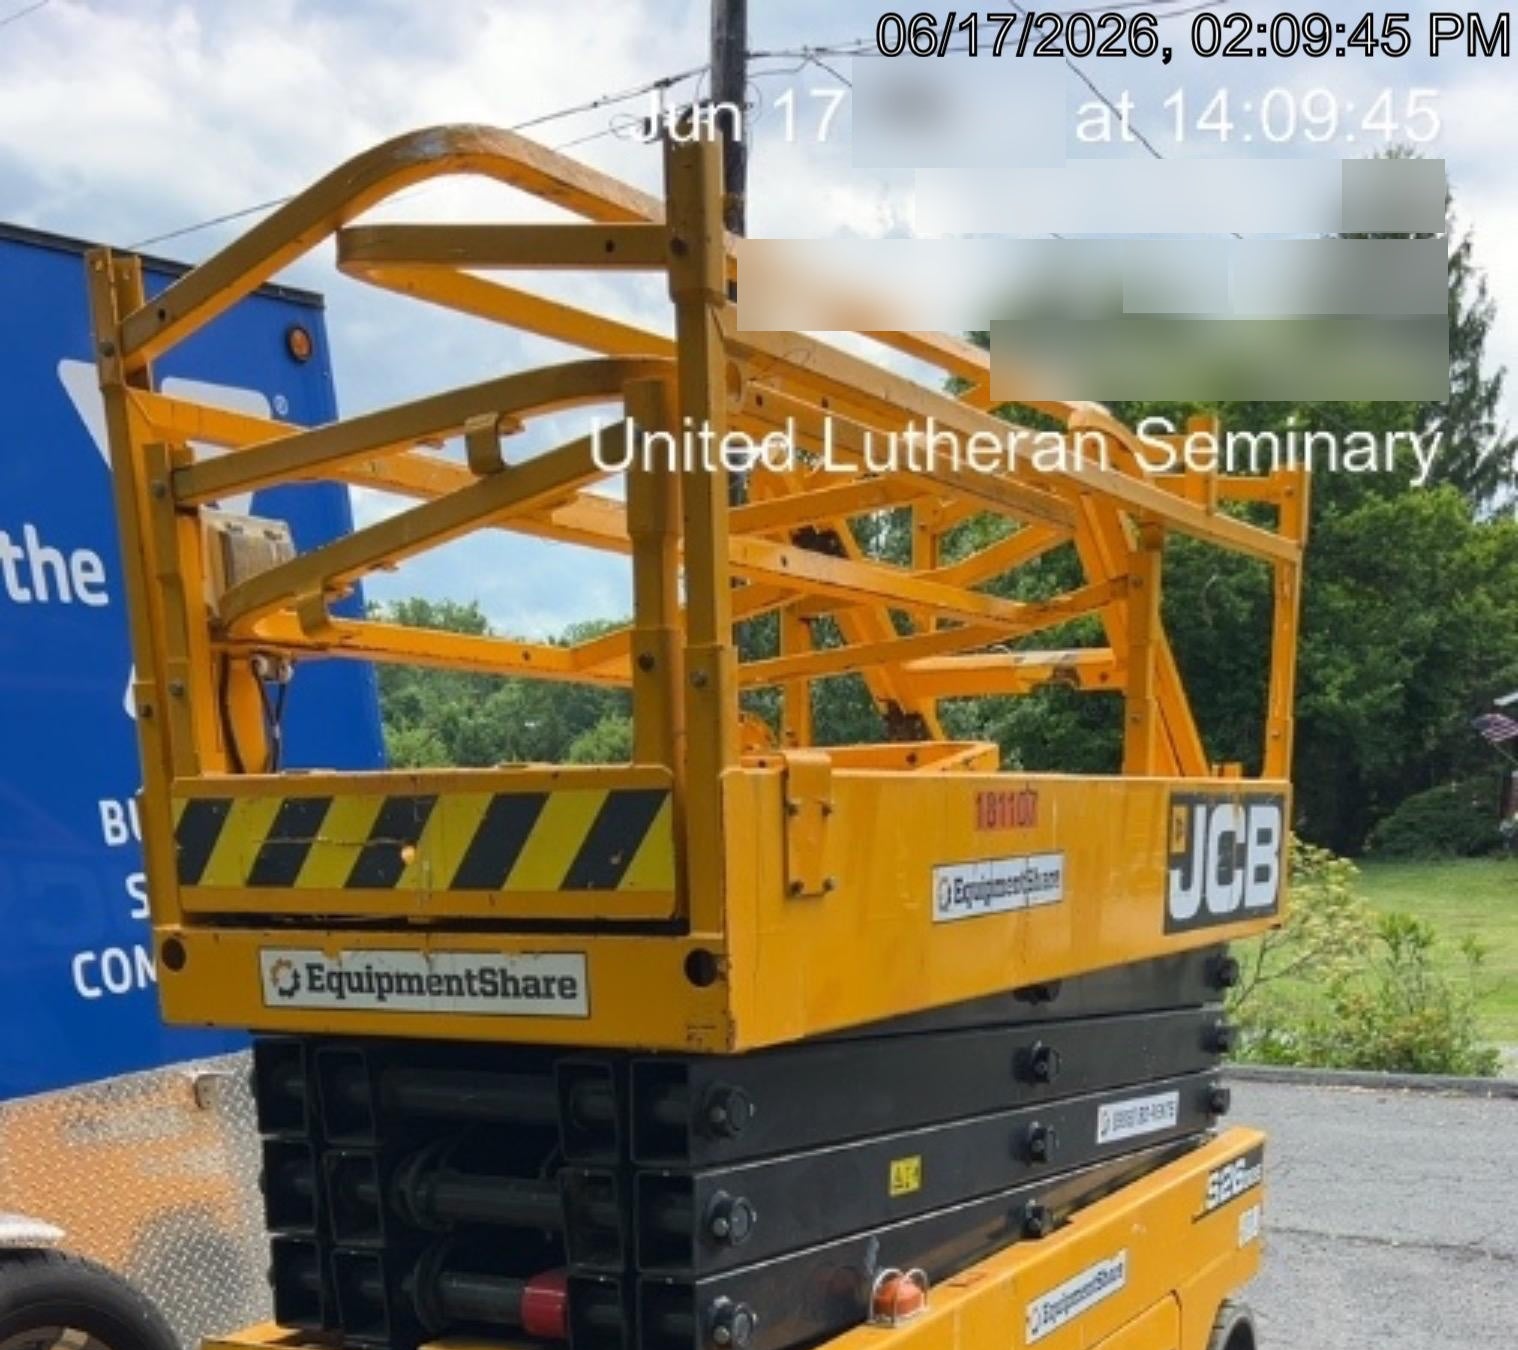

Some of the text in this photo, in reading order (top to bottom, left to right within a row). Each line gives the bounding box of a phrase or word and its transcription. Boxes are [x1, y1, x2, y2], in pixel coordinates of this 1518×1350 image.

[0, 522, 109, 607] the
[1169, 803, 1281, 920] JCB
[305, 963, 577, 1001] EquipmentShare
